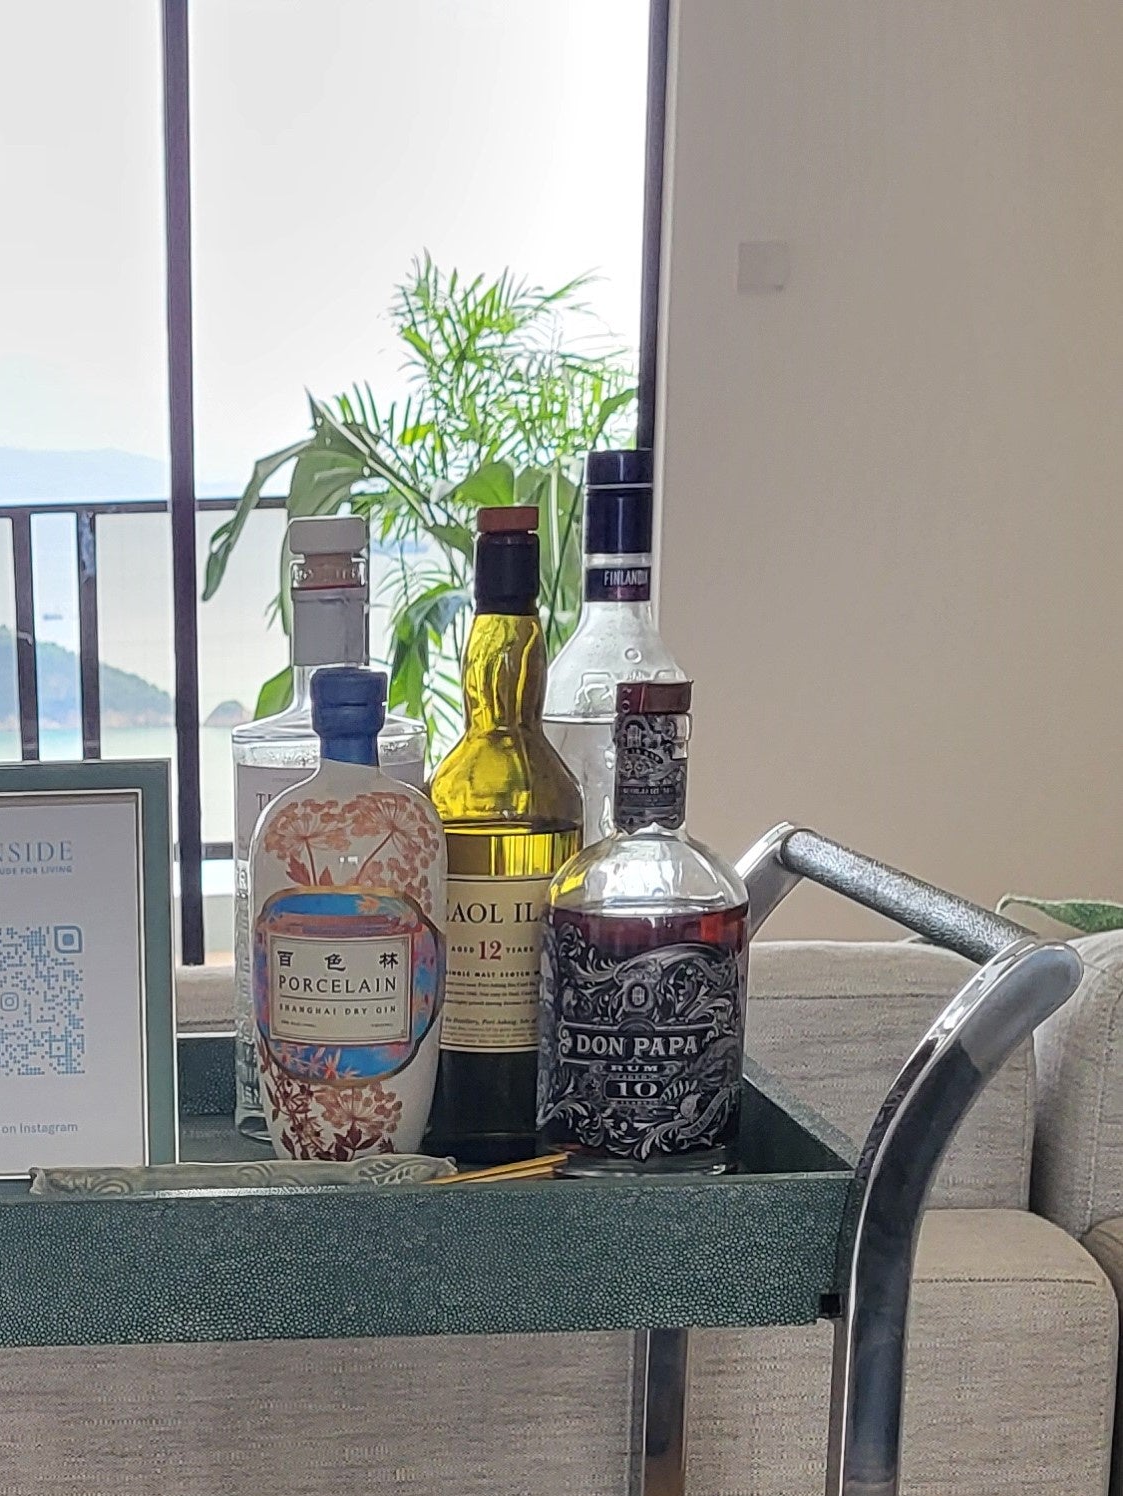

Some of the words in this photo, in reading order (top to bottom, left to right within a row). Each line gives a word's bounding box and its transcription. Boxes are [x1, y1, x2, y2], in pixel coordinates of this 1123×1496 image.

[20, 866, 38, 875] FOR
[41, 865, 72, 874] LIVING
[446, 898, 504, 924] AOL
[514, 902, 541, 924] IL
[478, 940, 502, 960] 12
[278, 975, 397, 994] PORCELAIN
[279, 1003, 337, 1015] SHANGHAI
[344, 1007, 368, 1015] DRY
[375, 1005, 397, 1015] GIN
[576, 1034, 625, 1056] DON
[633, 1035, 698, 1057] PAPA
[610, 1064, 659, 1073] RUM
[617, 1081, 658, 1098] 10
[2, 1125, 16, 1134] on
[19, 1122, 78, 1135] Instagram
